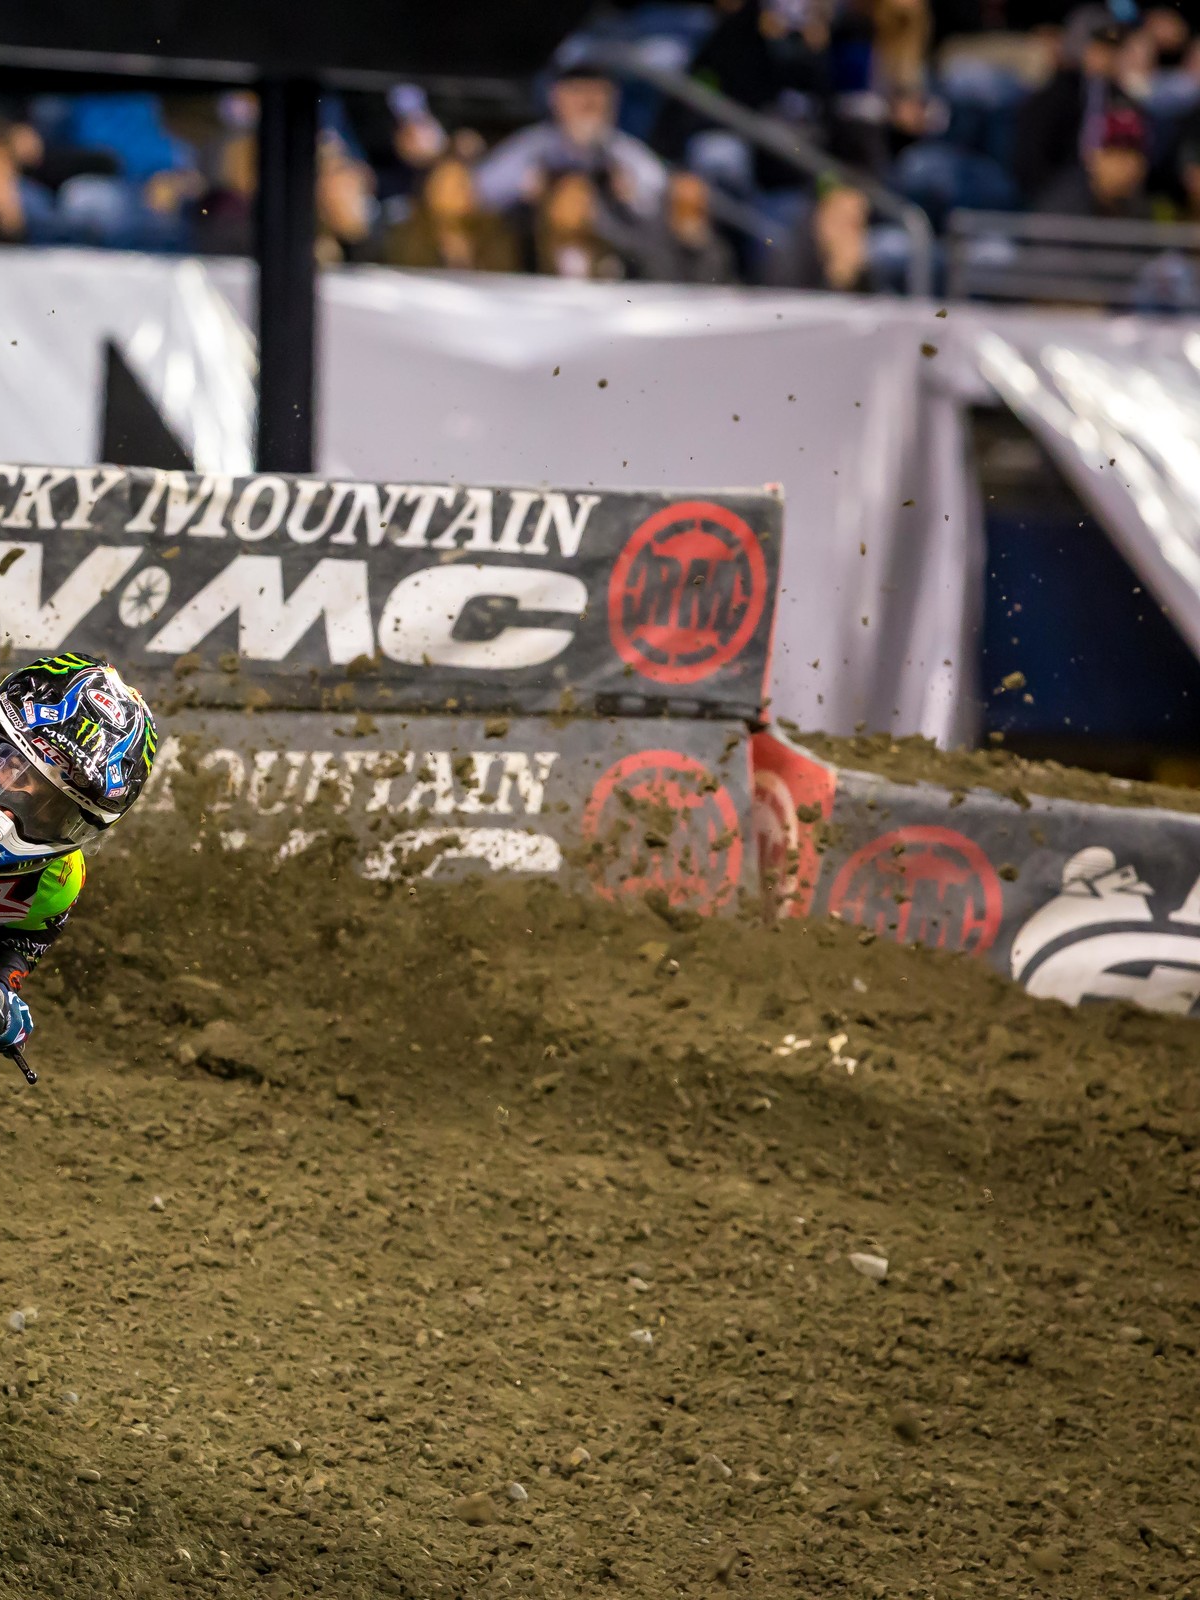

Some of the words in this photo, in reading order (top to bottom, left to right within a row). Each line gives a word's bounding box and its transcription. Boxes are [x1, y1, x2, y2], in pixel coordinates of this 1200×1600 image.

[124, 468, 601, 558] MOUNTAIN
[93, 693, 122, 722] BELL
[32, 737, 79, 779] FLEX
